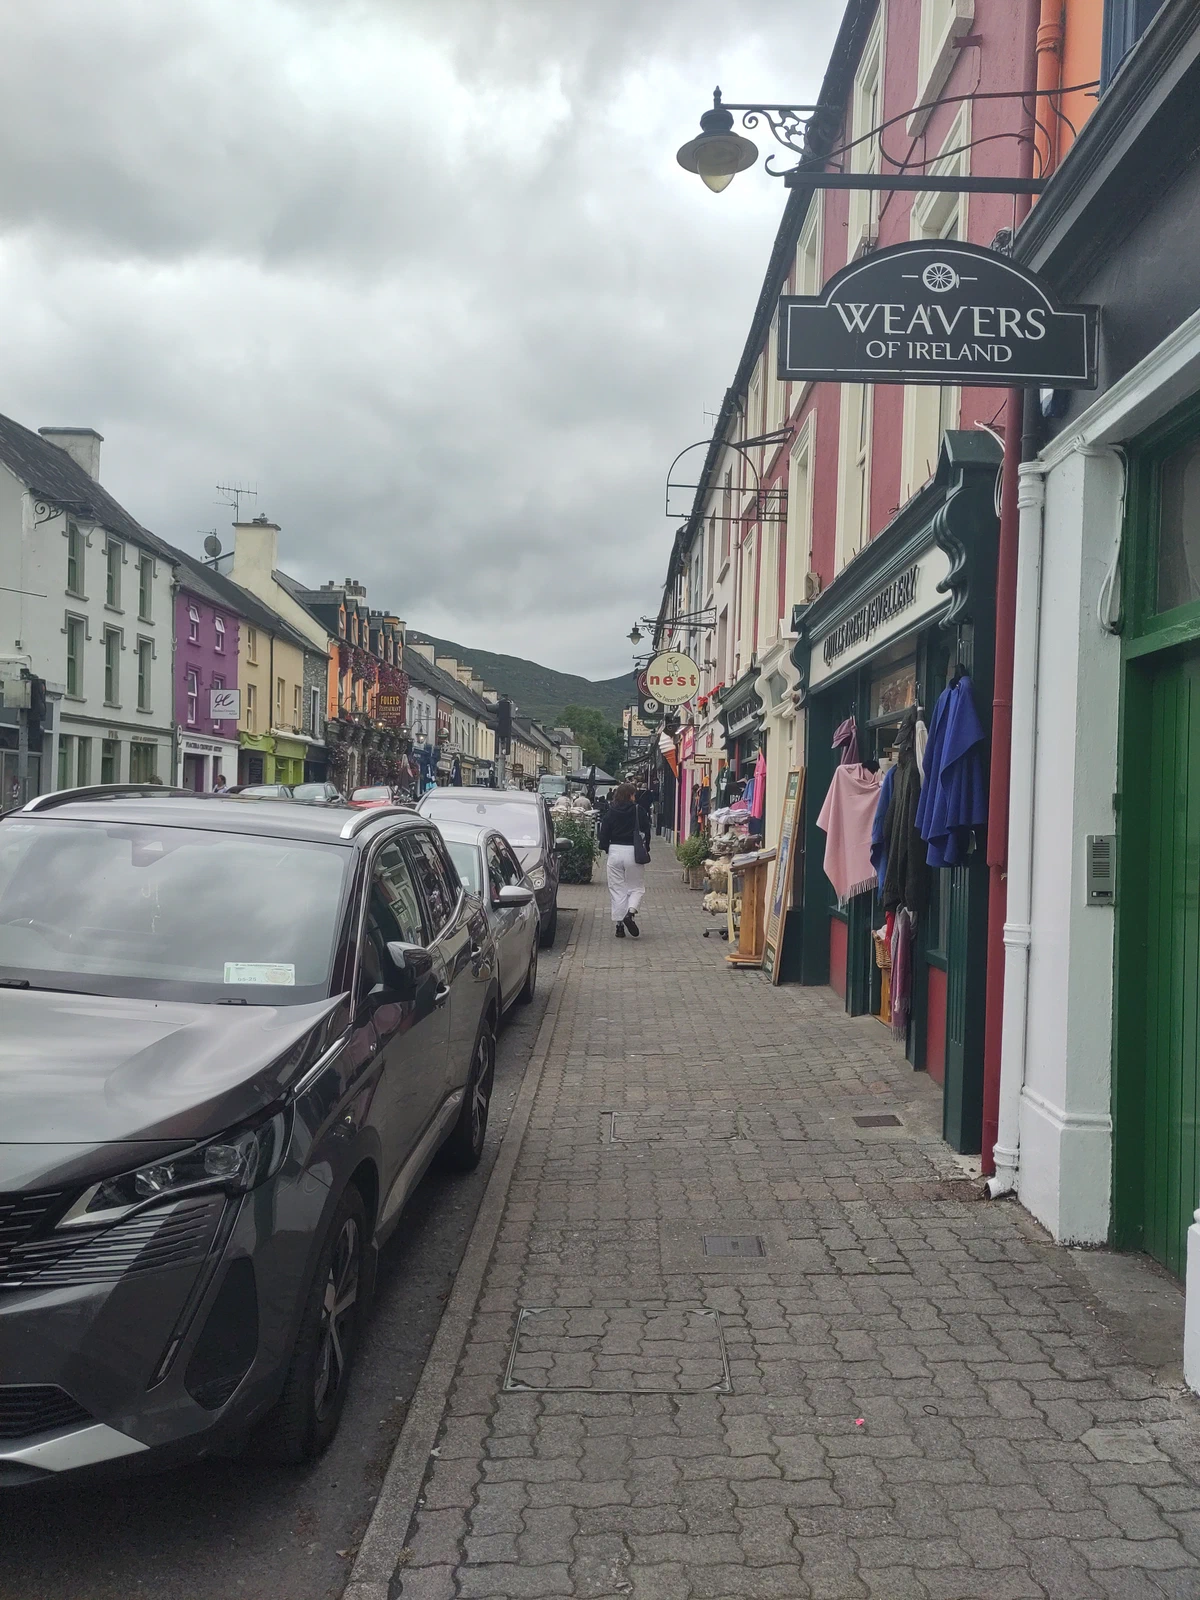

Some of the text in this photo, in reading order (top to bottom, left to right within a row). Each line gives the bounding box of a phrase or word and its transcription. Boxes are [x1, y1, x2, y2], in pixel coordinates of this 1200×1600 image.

[831, 302, 1046, 341] WEAVERS
[865, 340, 1012, 363] OF IRELAND
[823, 564, 919, 667] QUILLS IRISH JEWELLERY
[649, 674, 696, 687] nest
[380, 695, 400, 705] FOLEYS
